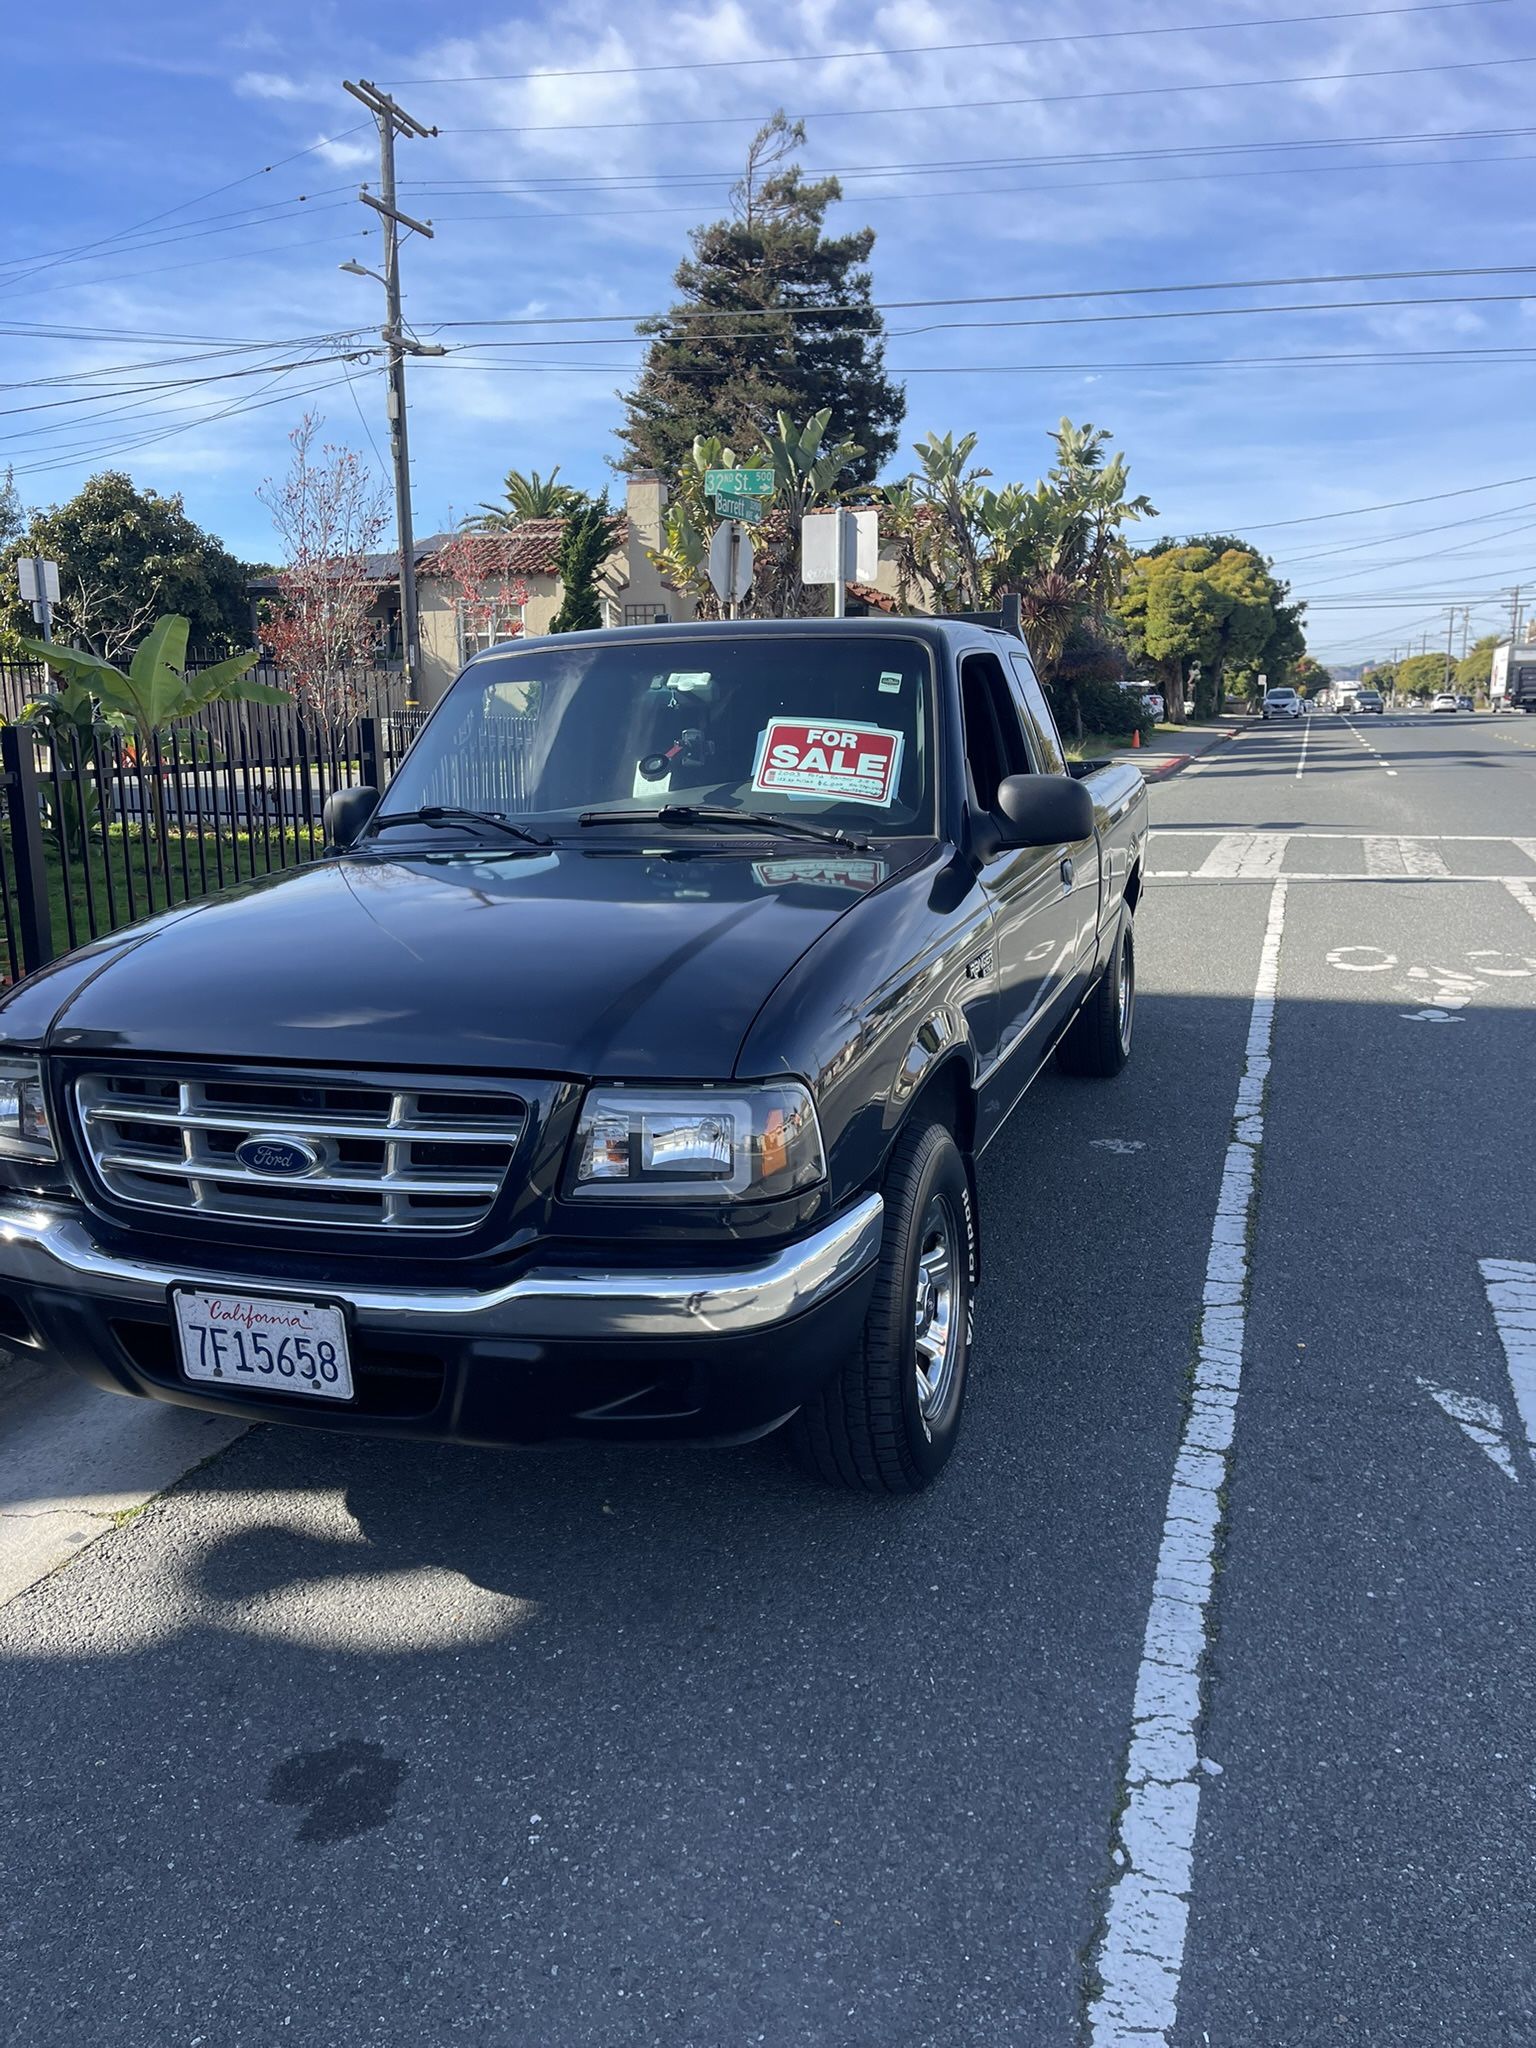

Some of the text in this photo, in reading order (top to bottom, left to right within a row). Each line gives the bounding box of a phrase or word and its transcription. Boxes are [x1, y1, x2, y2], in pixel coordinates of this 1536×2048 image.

[707, 472, 772, 491] 32ND St. 500
[717, 493, 745, 516] Barrett
[806, 728, 858, 749] FOR
[769, 744, 888, 779] SALE
[253, 1145, 293, 1168] Ford
[209, 1299, 313, 1330] California
[965, 1295, 975, 1346] T/A
[188, 1324, 339, 1382] 7F15658
